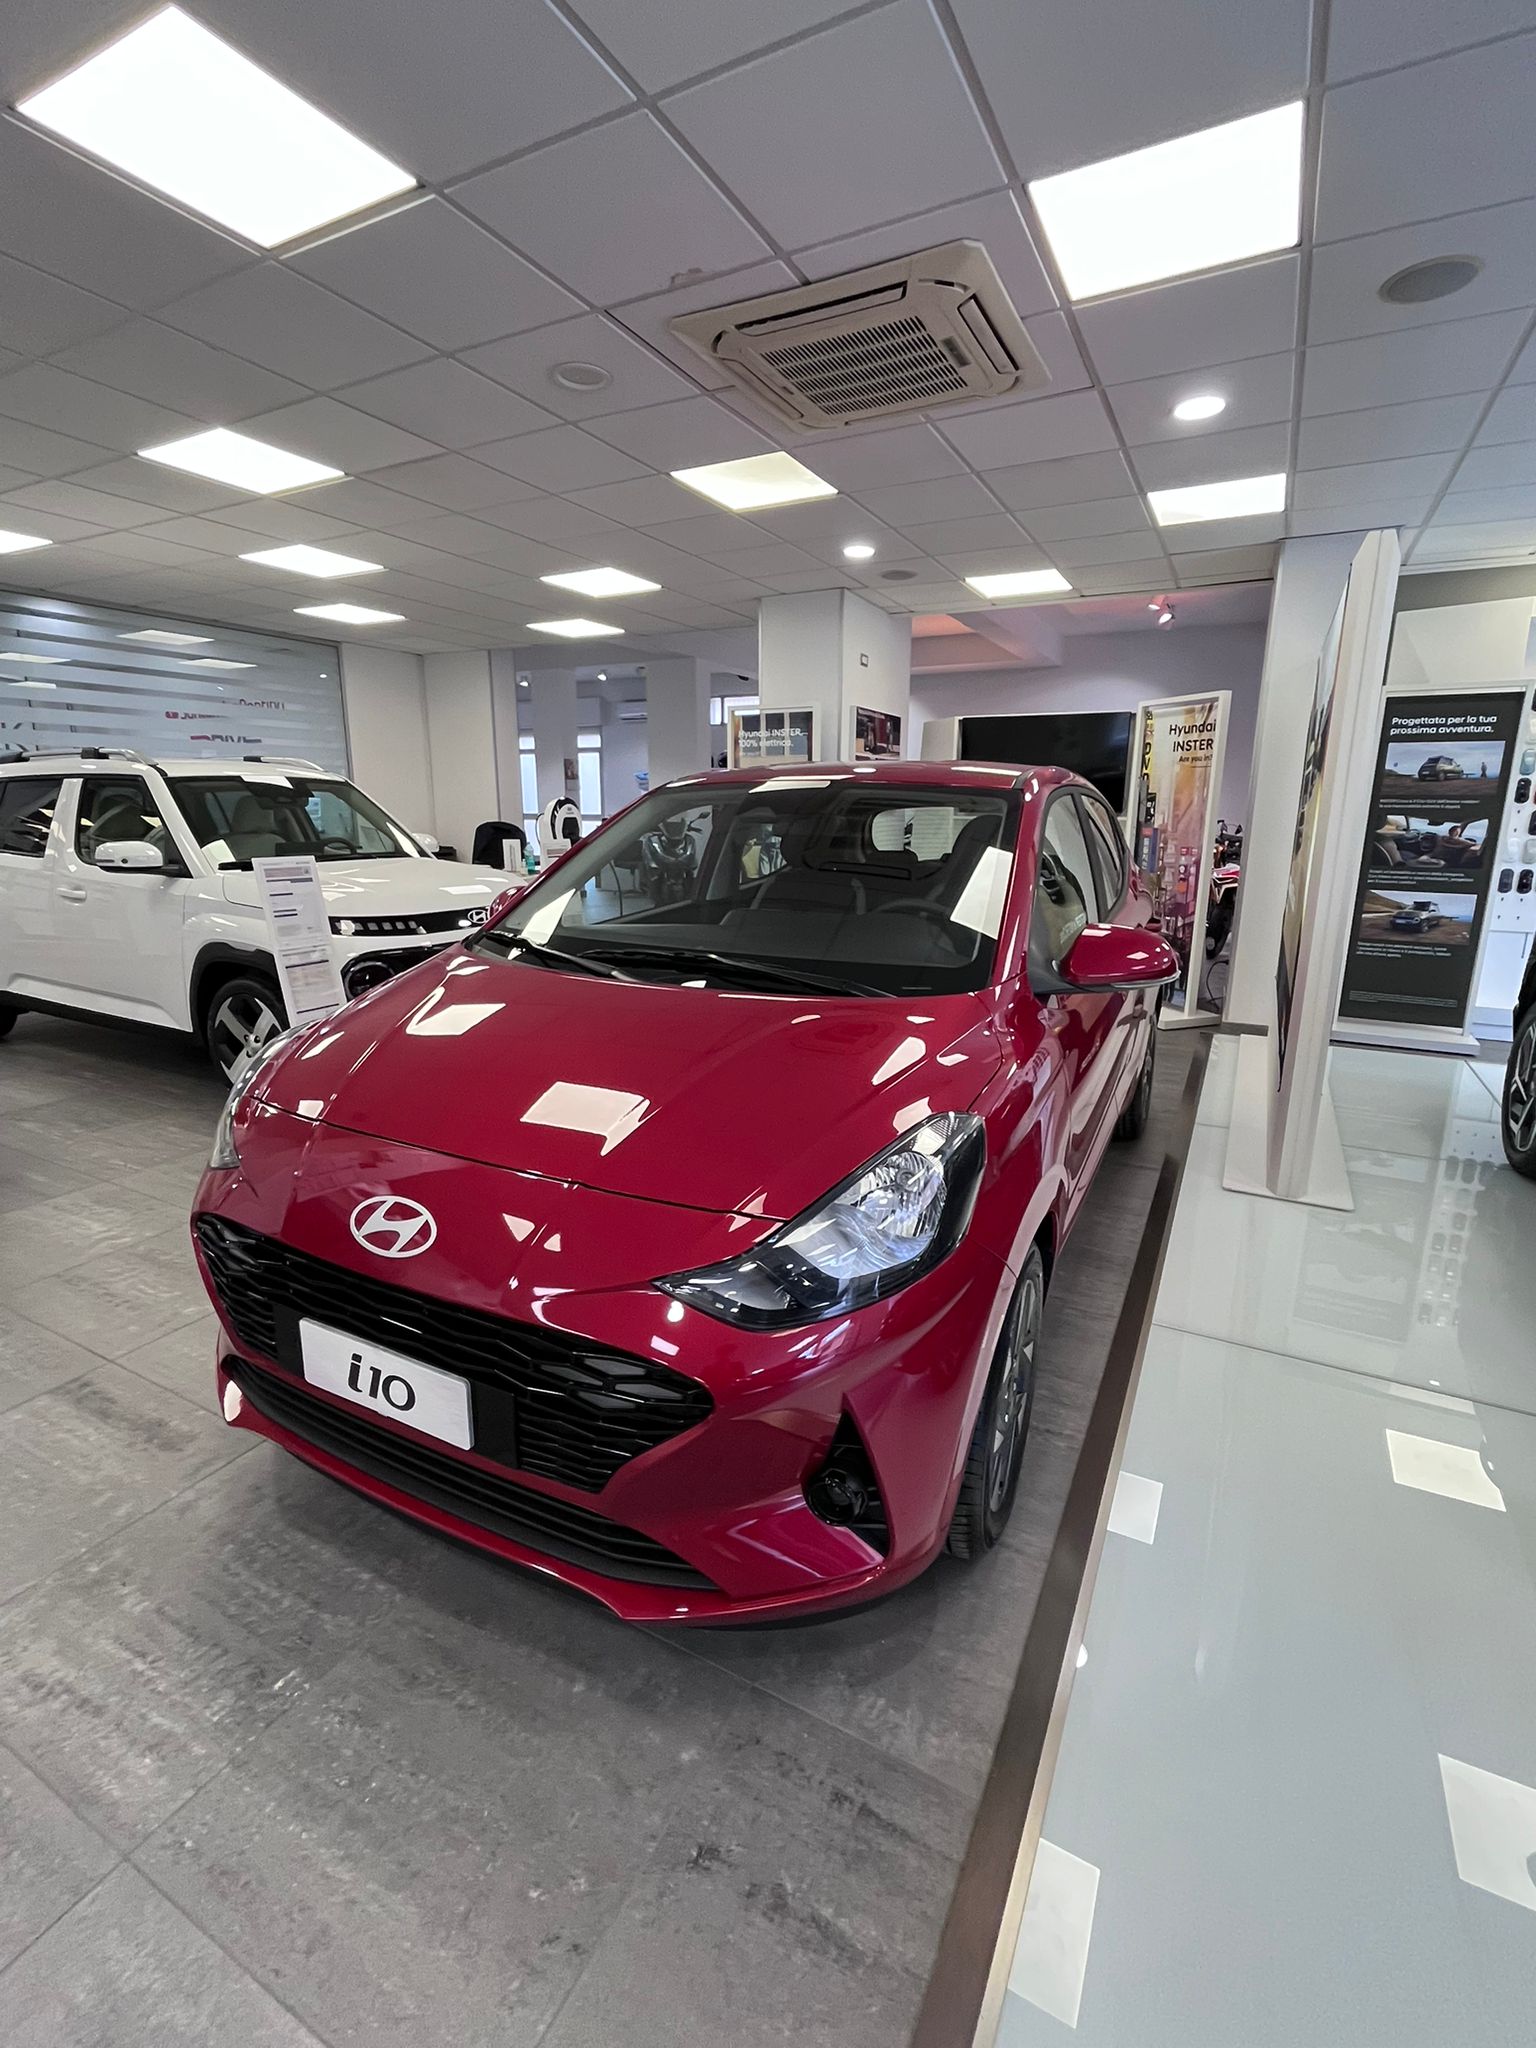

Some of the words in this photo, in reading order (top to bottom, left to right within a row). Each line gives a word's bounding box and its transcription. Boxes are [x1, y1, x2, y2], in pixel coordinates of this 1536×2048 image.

[1391, 717, 1446, 727] Progettata
[1447, 716, 1466, 725] per
[1466, 715, 1477, 723] la
[1479, 715, 1497, 723] tua
[1169, 719, 1217, 737] Hyundai
[1390, 726, 1436, 735] prossima
[1438, 724, 1494, 733] avventura.
[738, 729, 770, 740] Hyundai
[1172, 738, 1214, 753] INSTER
[1179, 755, 1189, 763] Are
[1190, 755, 1202, 764] you
[348, 1353, 416, 1411] i10
